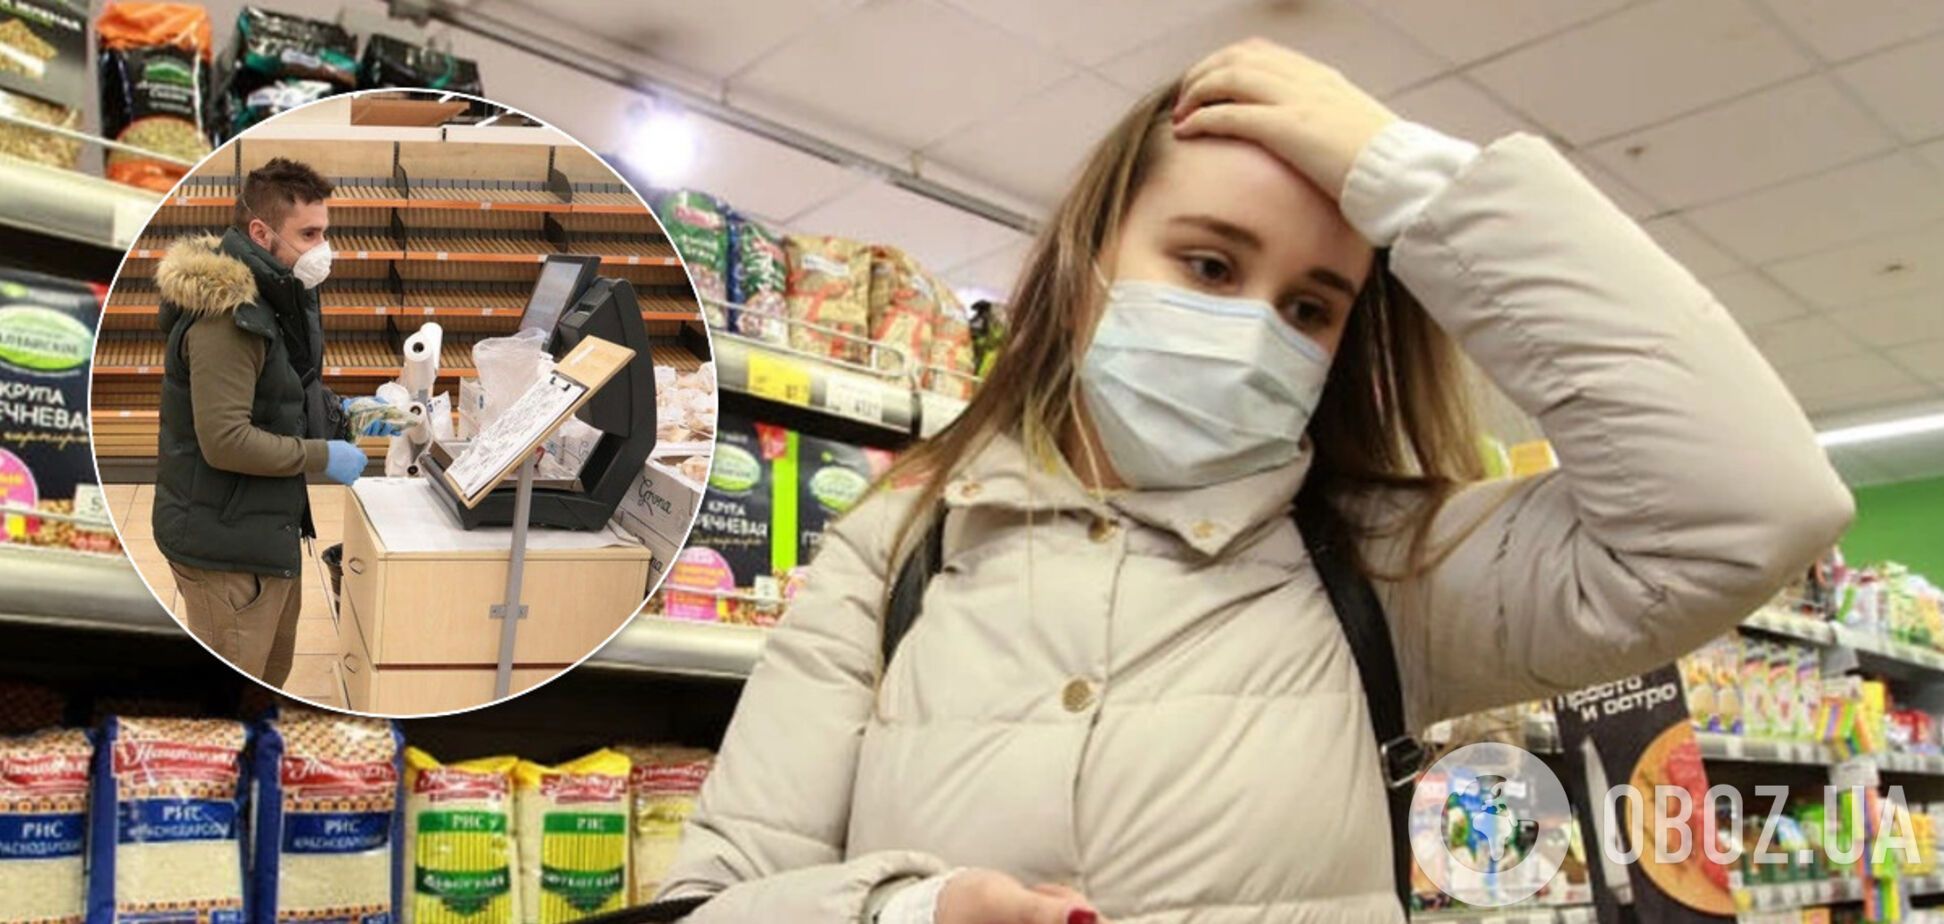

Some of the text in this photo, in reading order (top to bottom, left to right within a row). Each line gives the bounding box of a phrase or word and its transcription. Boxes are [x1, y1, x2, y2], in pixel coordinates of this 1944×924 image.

[0, 399, 90, 432] ЧНЕВА
[1603, 682, 1678, 716] остро
[163, 805, 203, 821] РИС
[23, 820, 63, 838] РИС
